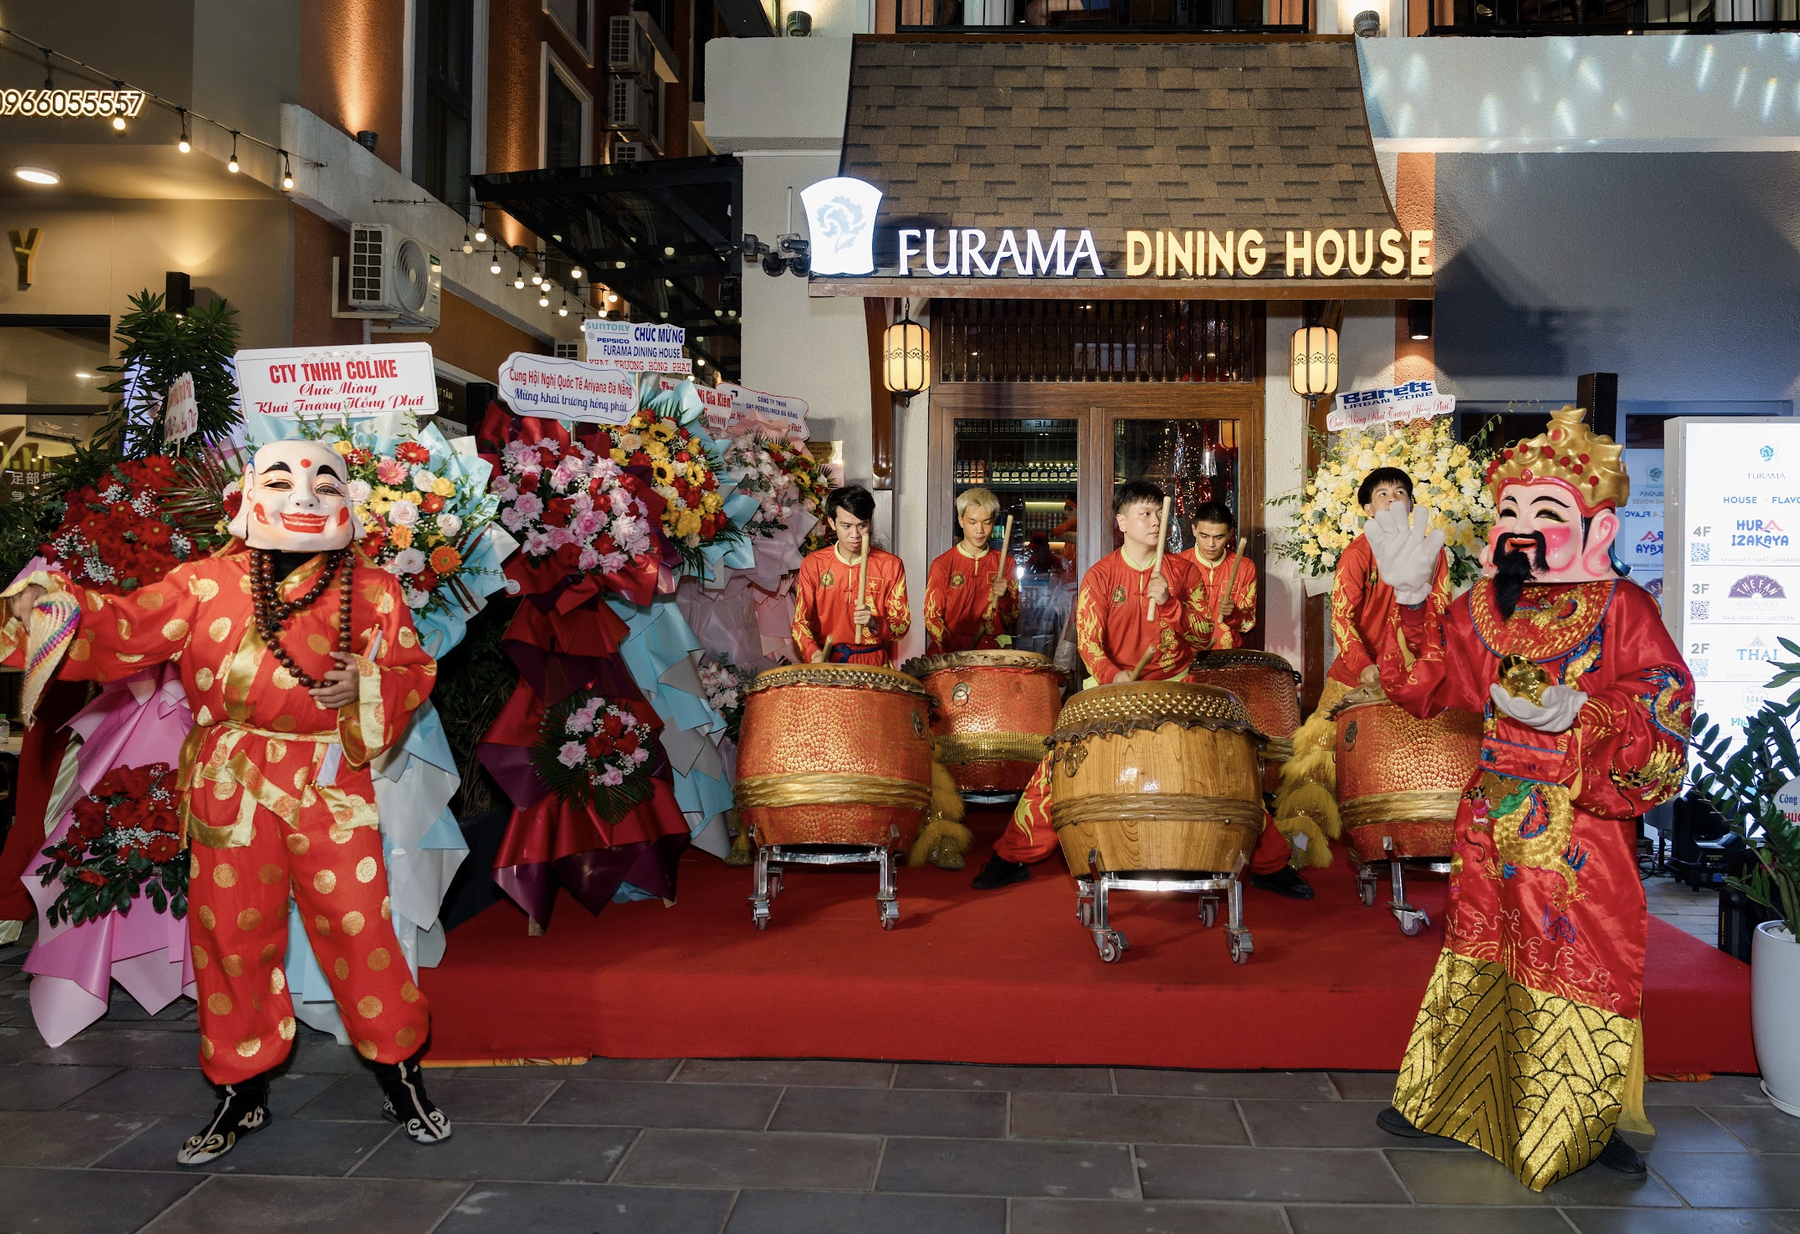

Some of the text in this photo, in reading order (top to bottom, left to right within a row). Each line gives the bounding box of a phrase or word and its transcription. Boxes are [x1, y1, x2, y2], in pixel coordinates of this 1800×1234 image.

[897, 228, 1434, 278] FURAMA DINING HOUSE
[634, 324, 683, 344] CHÚC MỪNG
[603, 344, 681, 359] FURAMA DINING HOUSE
[269, 359, 398, 384] CTY TNHH COLIKE
[672, 360, 691, 372] PHÁT
[299, 382, 378, 396] Chúc Mừng
[509, 368, 527, 386] Cung
[528, 370, 540, 387] Hội
[541, 373, 557, 389] Nghị
[557, 374, 573, 390] Quốc
[584, 379, 607, 394] Ariyana
[608, 381, 616, 394] Đà
[617, 380, 632, 399] Nẵng
[514, 387, 539, 405] Mừng
[540, 390, 560, 404] khai
[561, 397, 588, 410] trương
[610, 402, 627, 413] phát
[706, 391, 716, 405] Gia
[1339, 381, 1432, 405] Barett
[1344, 391, 1434, 410] URBAN ZONE
[253, 401, 289, 414] Khai
[346, 396, 384, 410] Hồng
[388, 394, 424, 409] Phát
[1747, 472, 1786, 480] FURAMA
[1723, 496, 1758, 504] HOUSE
[1692, 526, 1712, 537] 4F
[1736, 519, 1784, 534] HURA
[1731, 534, 1789, 549] IZAKAYA
[1692, 583, 1710, 595] 3F
[1736, 579, 1778, 596] THE FAN
[1691, 643, 1710, 654] 2F
[1736, 648, 1778, 661] THAI
[1779, 794, 1798, 806] Công
